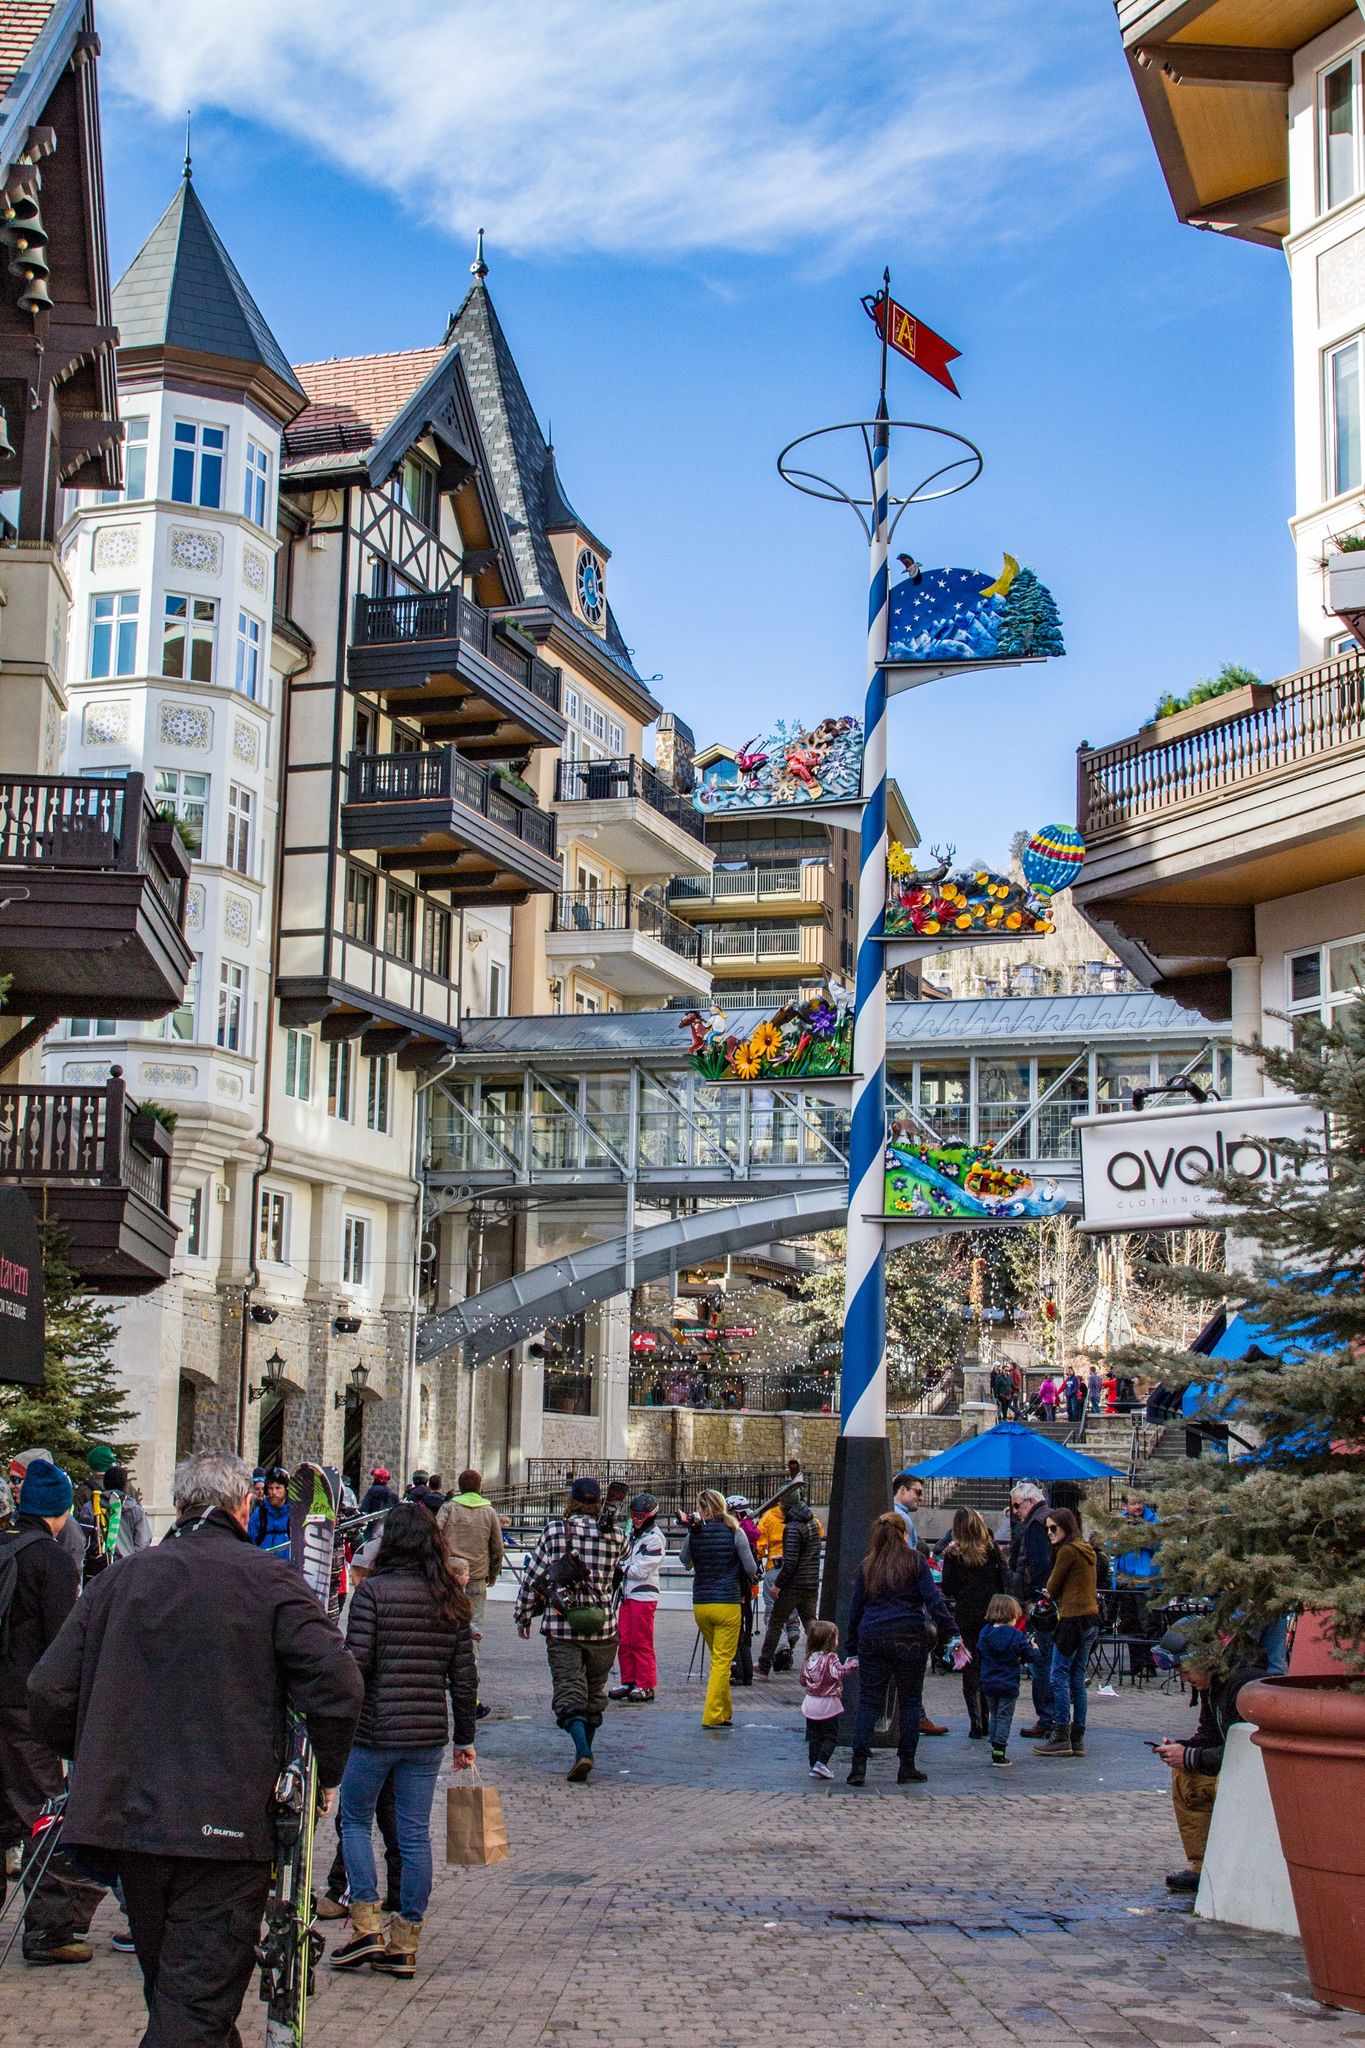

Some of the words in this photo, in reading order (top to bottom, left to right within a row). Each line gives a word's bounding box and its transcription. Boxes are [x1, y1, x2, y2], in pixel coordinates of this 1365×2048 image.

[897, 315, 914, 351] A
[1107, 1130, 1302, 1192] avalon
[1117, 1195, 1202, 1209] CLOTHING
[0, 1252, 29, 1297] tavern
[213, 1828, 244, 1838] sunice
